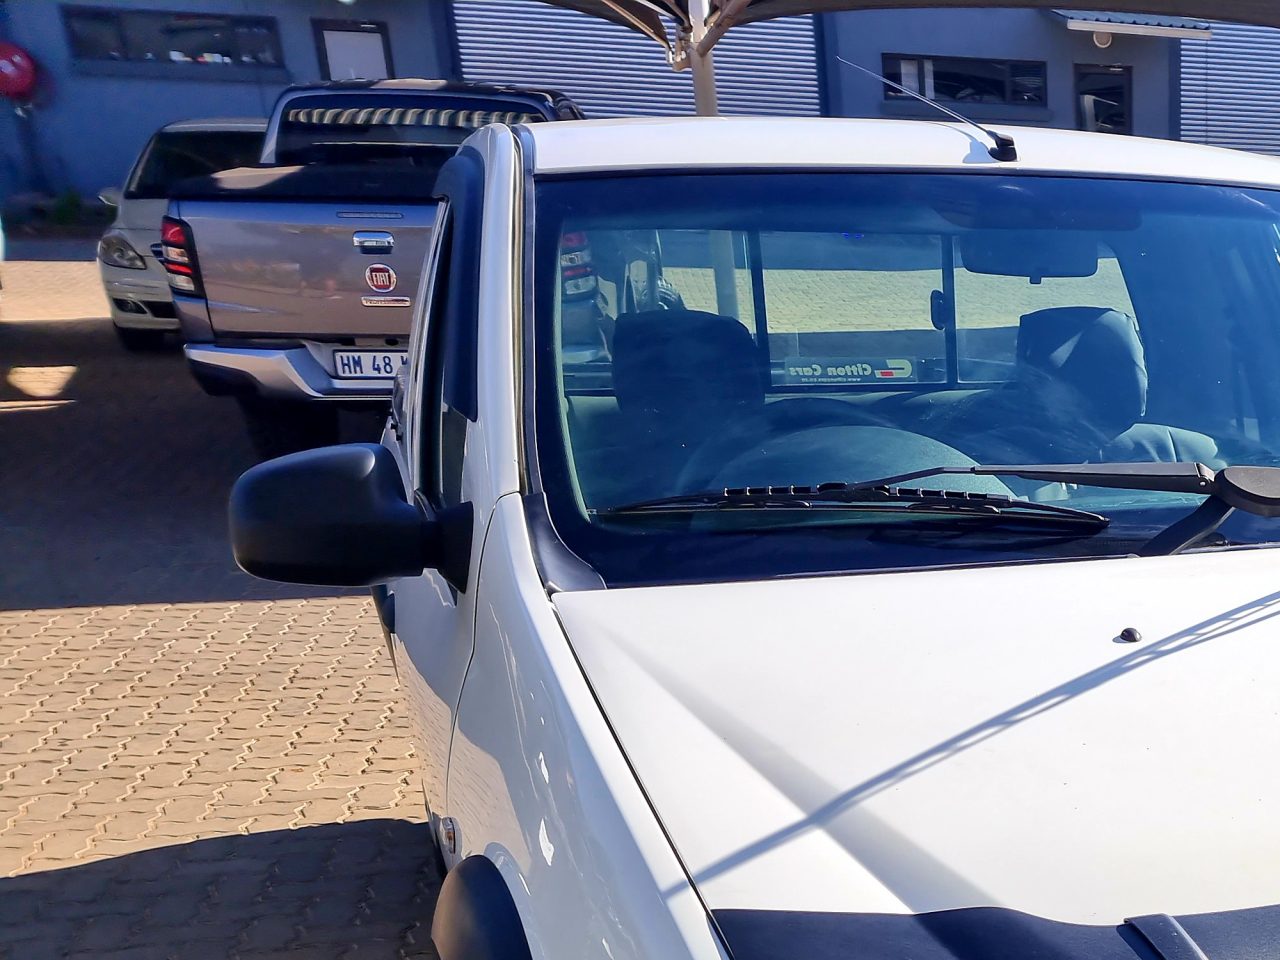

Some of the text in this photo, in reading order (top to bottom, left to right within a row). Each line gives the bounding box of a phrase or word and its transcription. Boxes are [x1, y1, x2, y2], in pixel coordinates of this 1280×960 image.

[371, 272, 390, 286] FIAT
[340, 355, 364, 374] HM
[372, 355, 393, 375] 48
